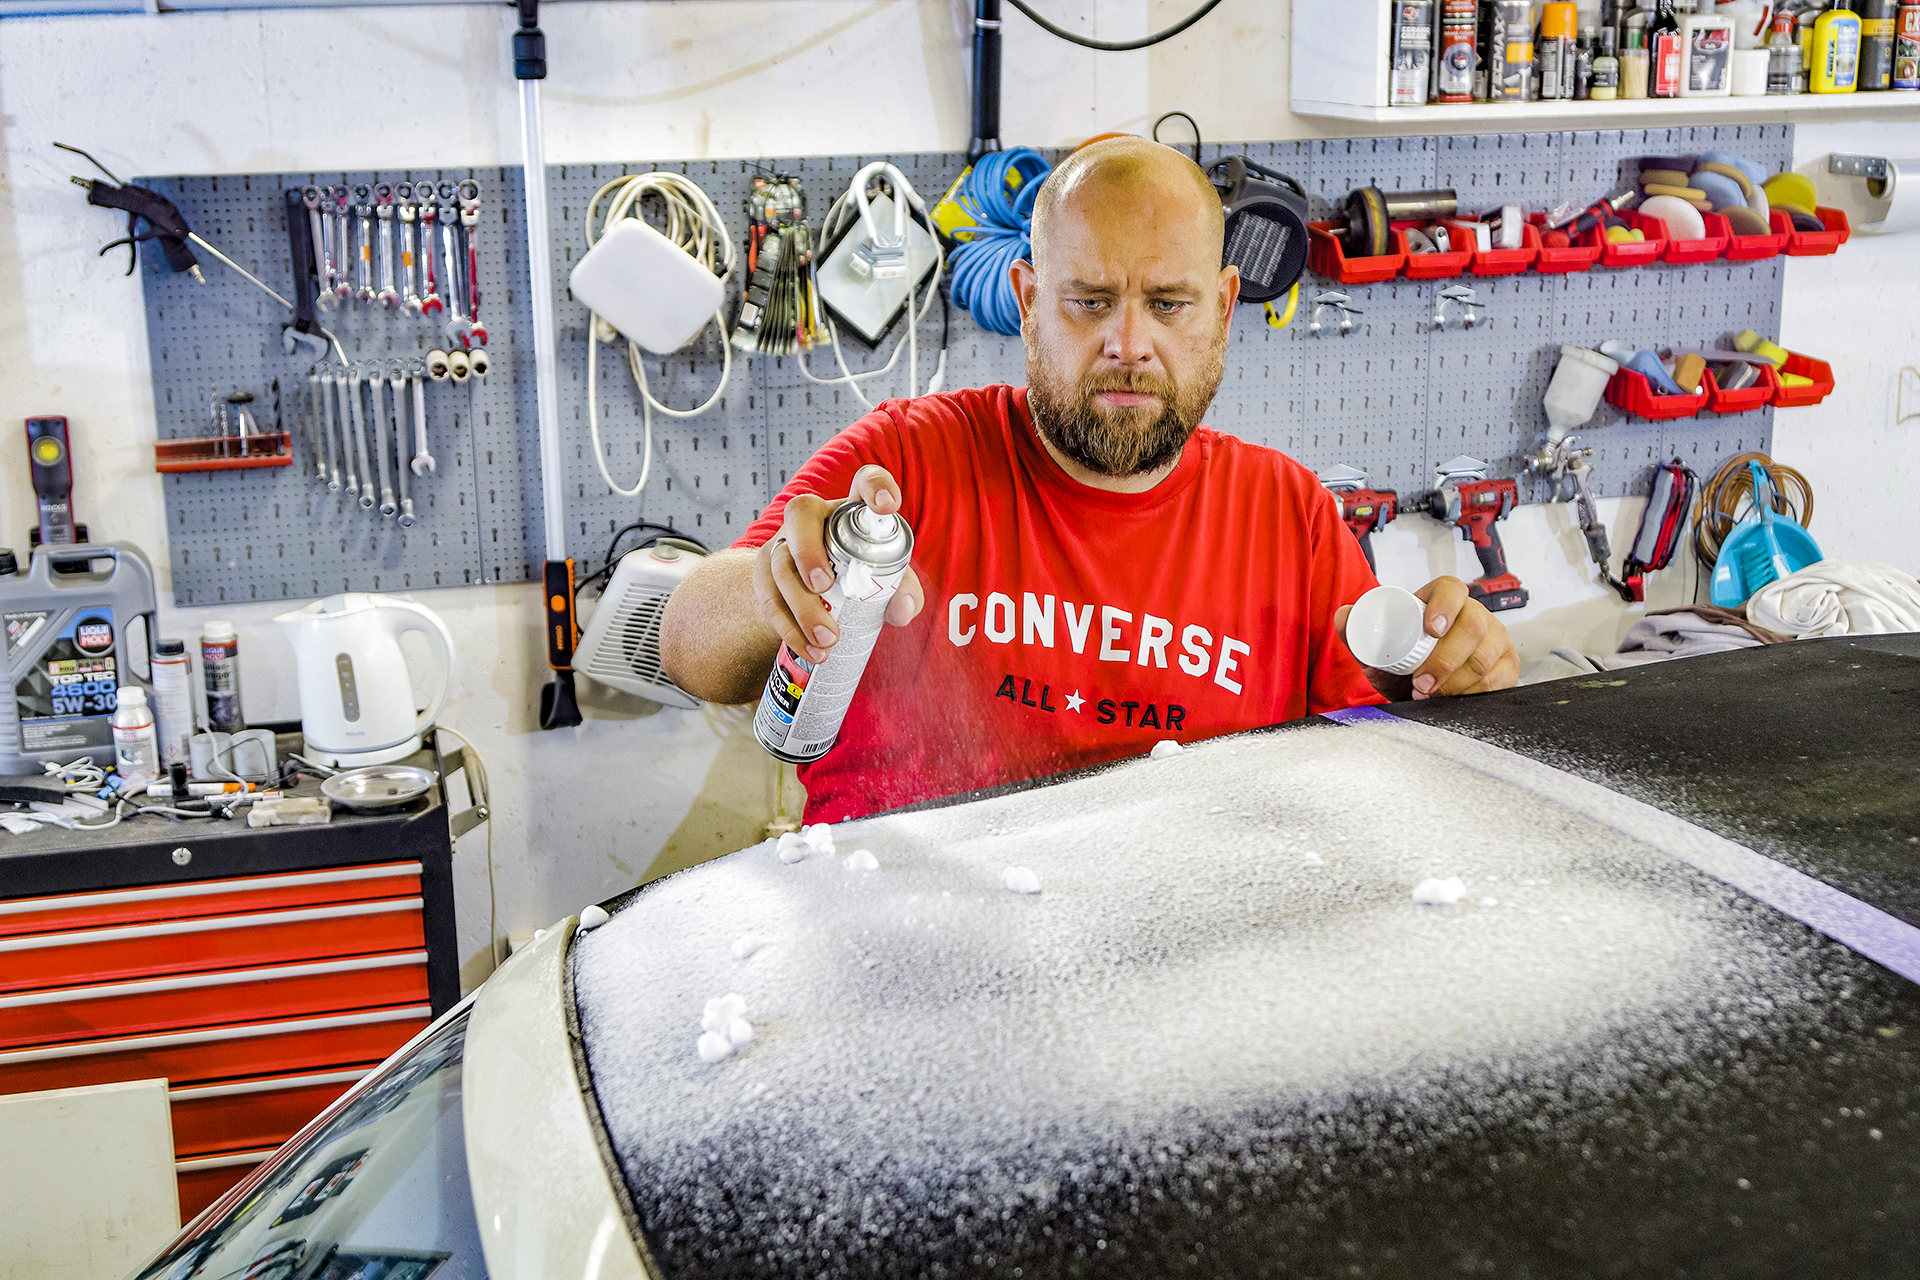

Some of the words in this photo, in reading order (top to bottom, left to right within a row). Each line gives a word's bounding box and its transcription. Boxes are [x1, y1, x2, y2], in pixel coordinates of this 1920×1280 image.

[80, 625, 109, 635] LIQUI
[81, 635, 111, 646] MOLY
[949, 591, 1250, 695] CONVERSE
[51, 673, 83, 686] TOP
[84, 671, 115, 682] TEC
[51, 681, 116, 697] 4600
[52, 693, 117, 714] 5W-30
[995, 674, 1056, 713] ALL
[1096, 699, 1187, 731] STAR
